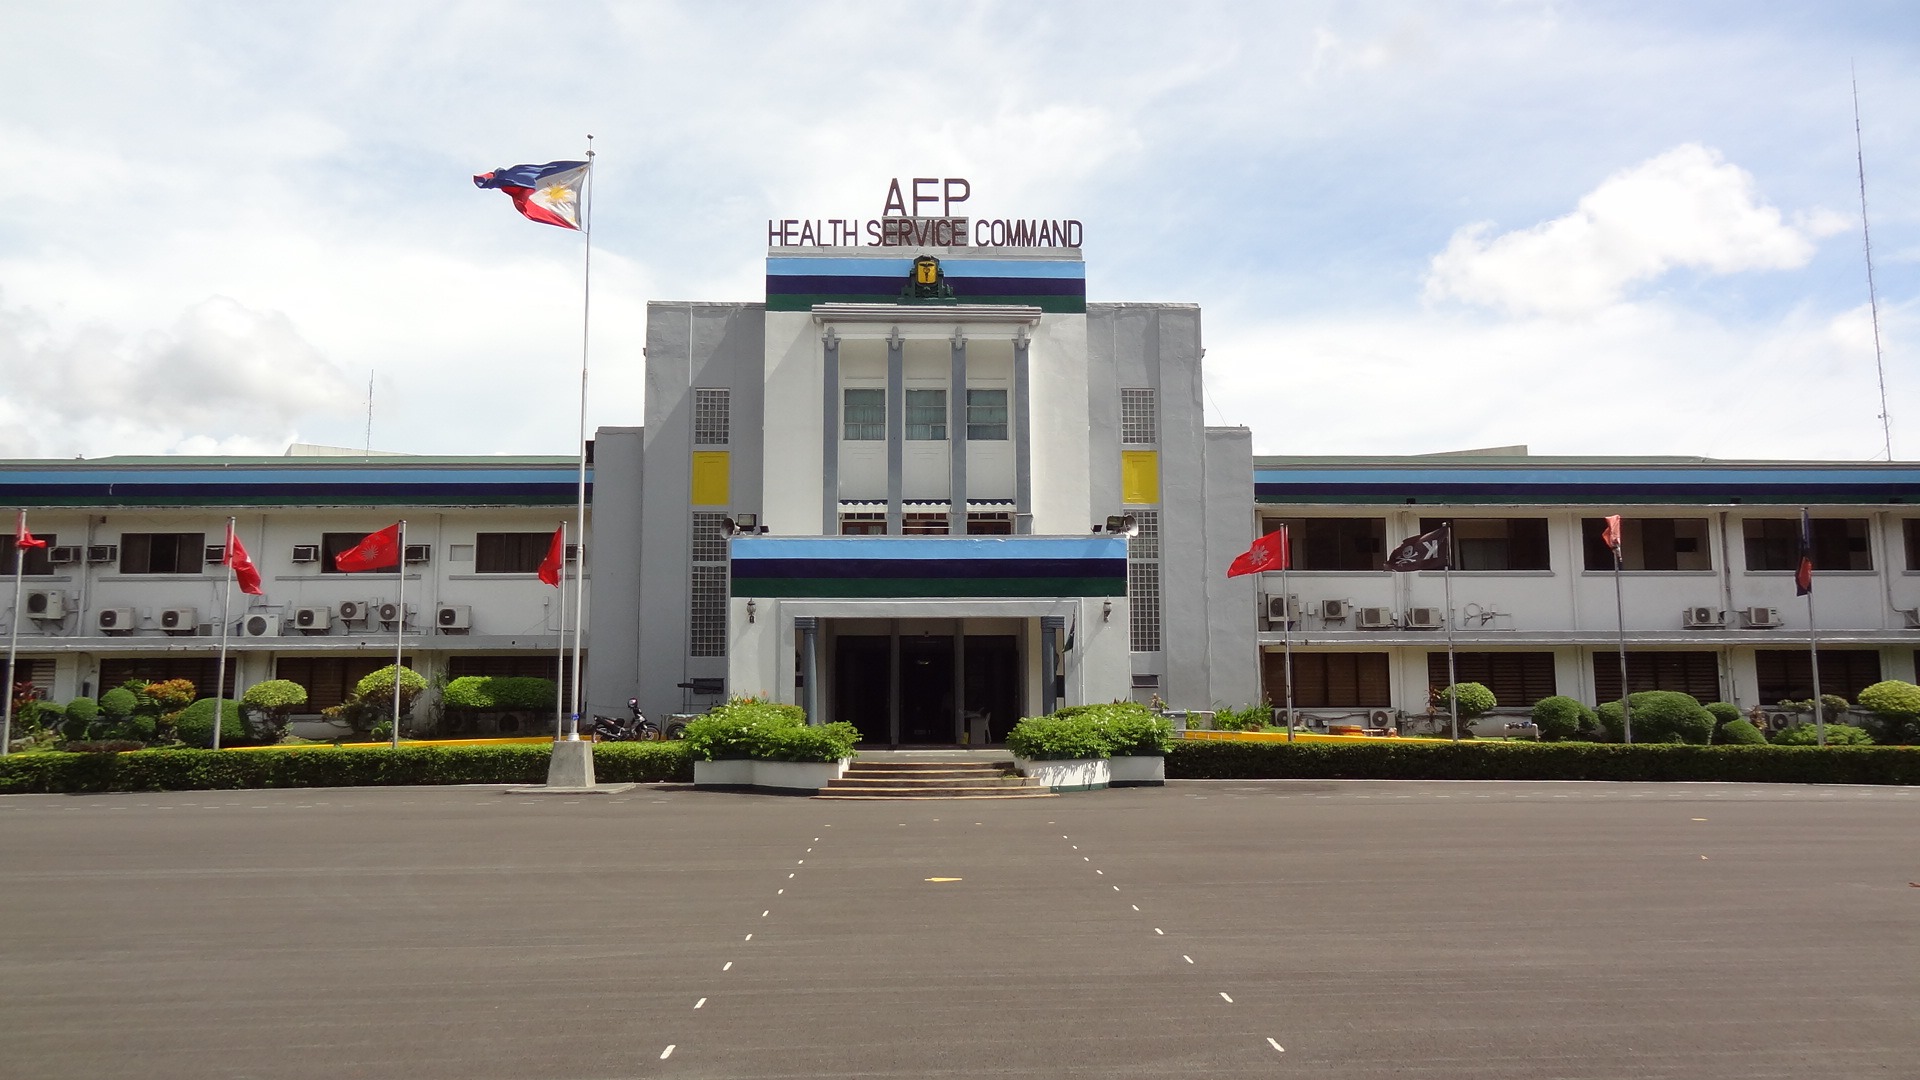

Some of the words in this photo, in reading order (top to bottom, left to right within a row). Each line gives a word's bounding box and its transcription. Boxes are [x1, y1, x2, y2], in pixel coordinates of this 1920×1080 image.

[883, 178, 970, 217] AFP
[768, 219, 858, 247] HEALTH
[866, 219, 968, 247] SERVICE
[975, 219, 1083, 248] COMMAND
